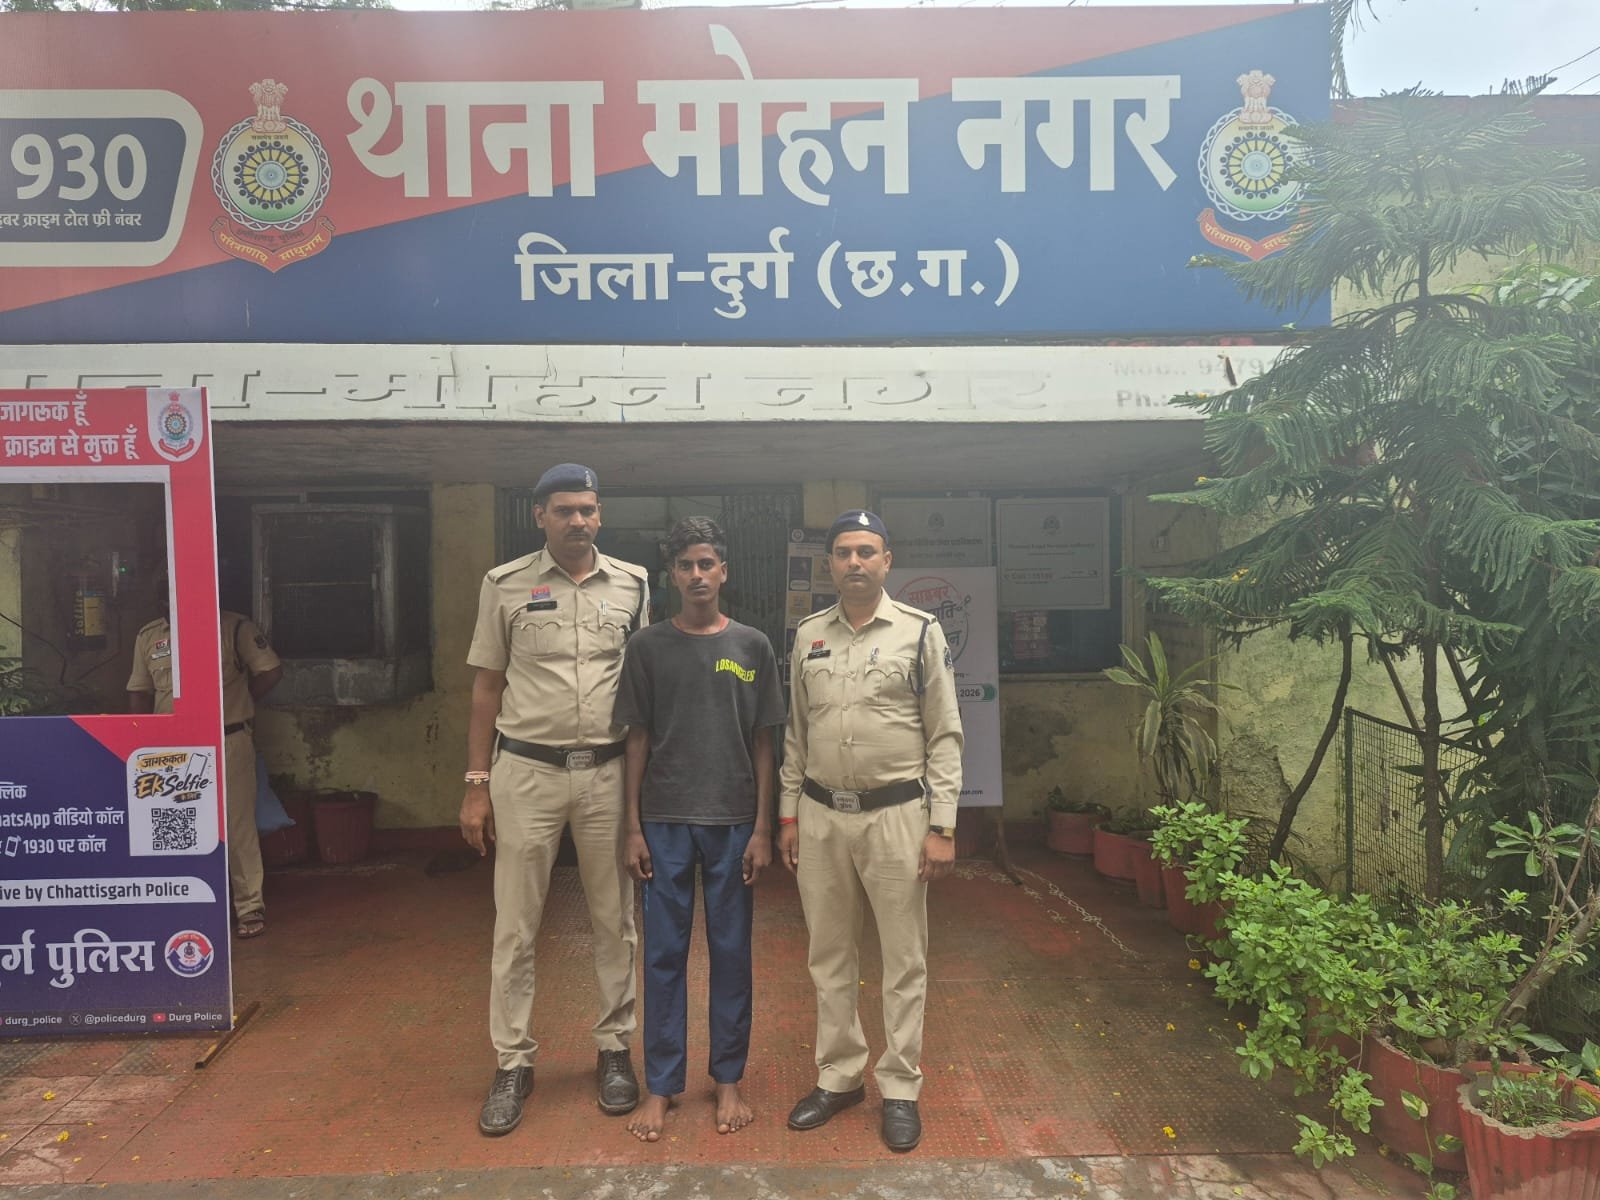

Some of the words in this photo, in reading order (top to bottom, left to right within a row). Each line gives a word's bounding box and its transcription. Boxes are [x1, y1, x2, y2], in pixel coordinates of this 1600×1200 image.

[346, 77, 604, 197] थाना
[637, 24, 920, 207] मोहन
[952, 75, 1181, 192] नगर
[23, 212, 60, 229] क्राइम
[64, 208, 88, 227] टोल
[115, 208, 142, 227] नंबर
[514, 226, 795, 320] जिला-दुर्ग
[817, 236, 1020, 310] (छ.ग.)
[72, 391, 90, 426] हूँ
[3, 434, 57, 458] क्राइम
[59, 429, 80, 456] से
[122, 424, 140, 460] हूँ
[135, 773, 164, 799] Ek
[161, 773, 209, 797] Selfie
[53, 807, 93, 826] वीडियो
[95, 806, 125, 825] कॉल
[23, 838, 54, 854] 1930
[57, 838, 75, 853] पर
[77, 834, 107, 852] कॉल
[25, 885, 43, 902] by
[47, 883, 141, 901] Chhattisgarh
[145, 881, 189, 897] Police
[46, 928, 156, 989] पुलिस
[5, 1015, 62, 1027] durg_police
[84, 1013, 146, 1025] @policedurg
[169, 1013, 192, 1024] Durg
[194, 1012, 223, 1022] Police
